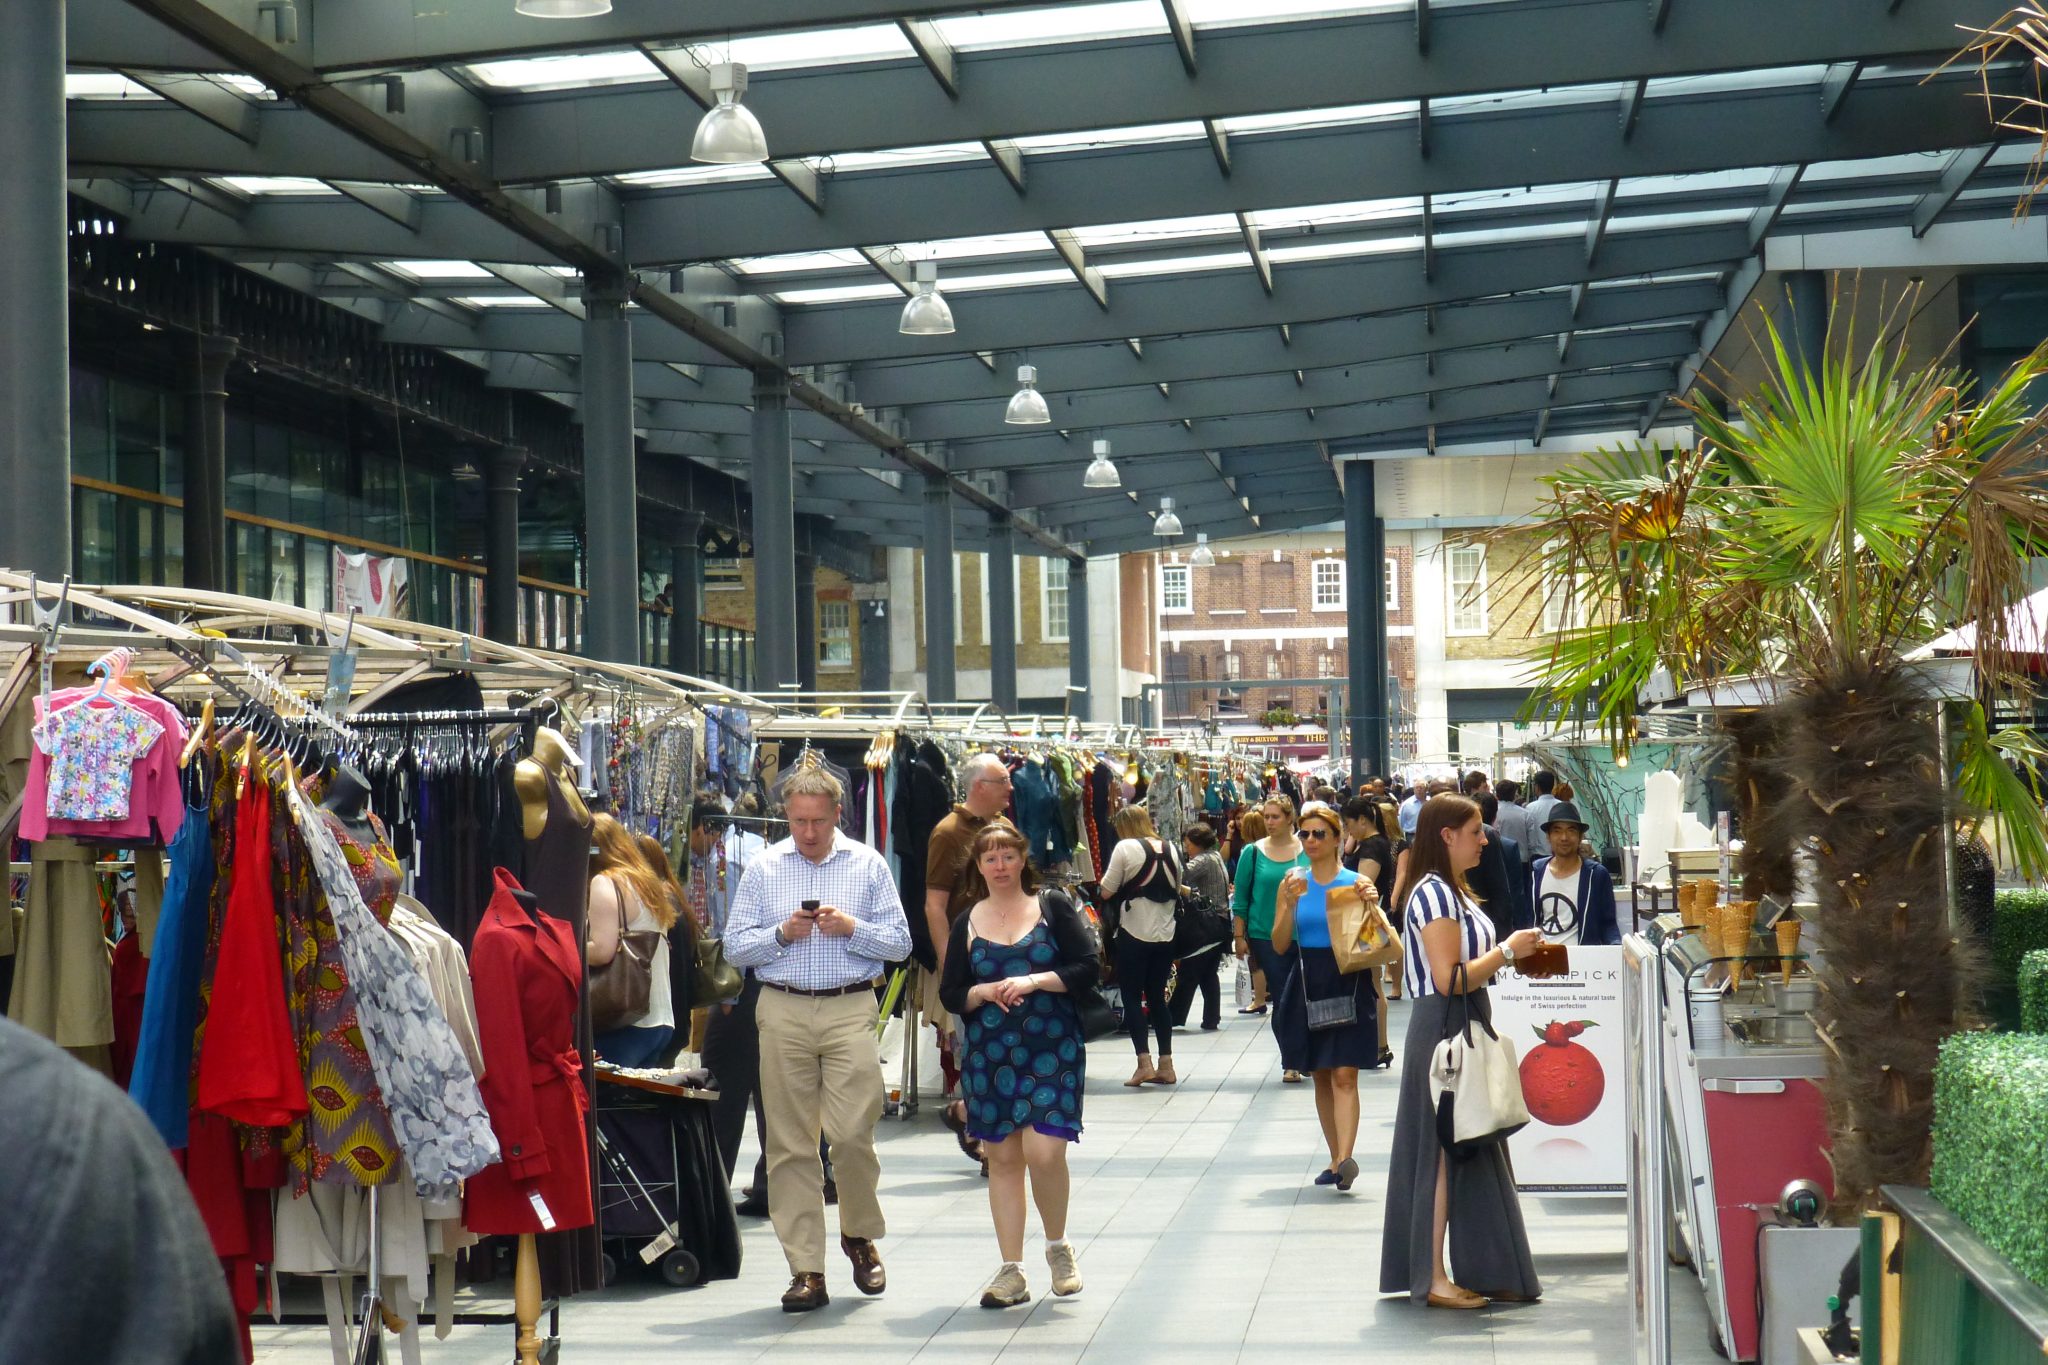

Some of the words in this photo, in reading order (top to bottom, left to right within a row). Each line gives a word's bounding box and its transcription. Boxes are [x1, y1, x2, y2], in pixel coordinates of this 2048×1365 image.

[1304, 733, 1326, 743] THE
[1497, 970, 1617, 980] MONPICK
[1556, 1002, 1587, 1010] perfection
